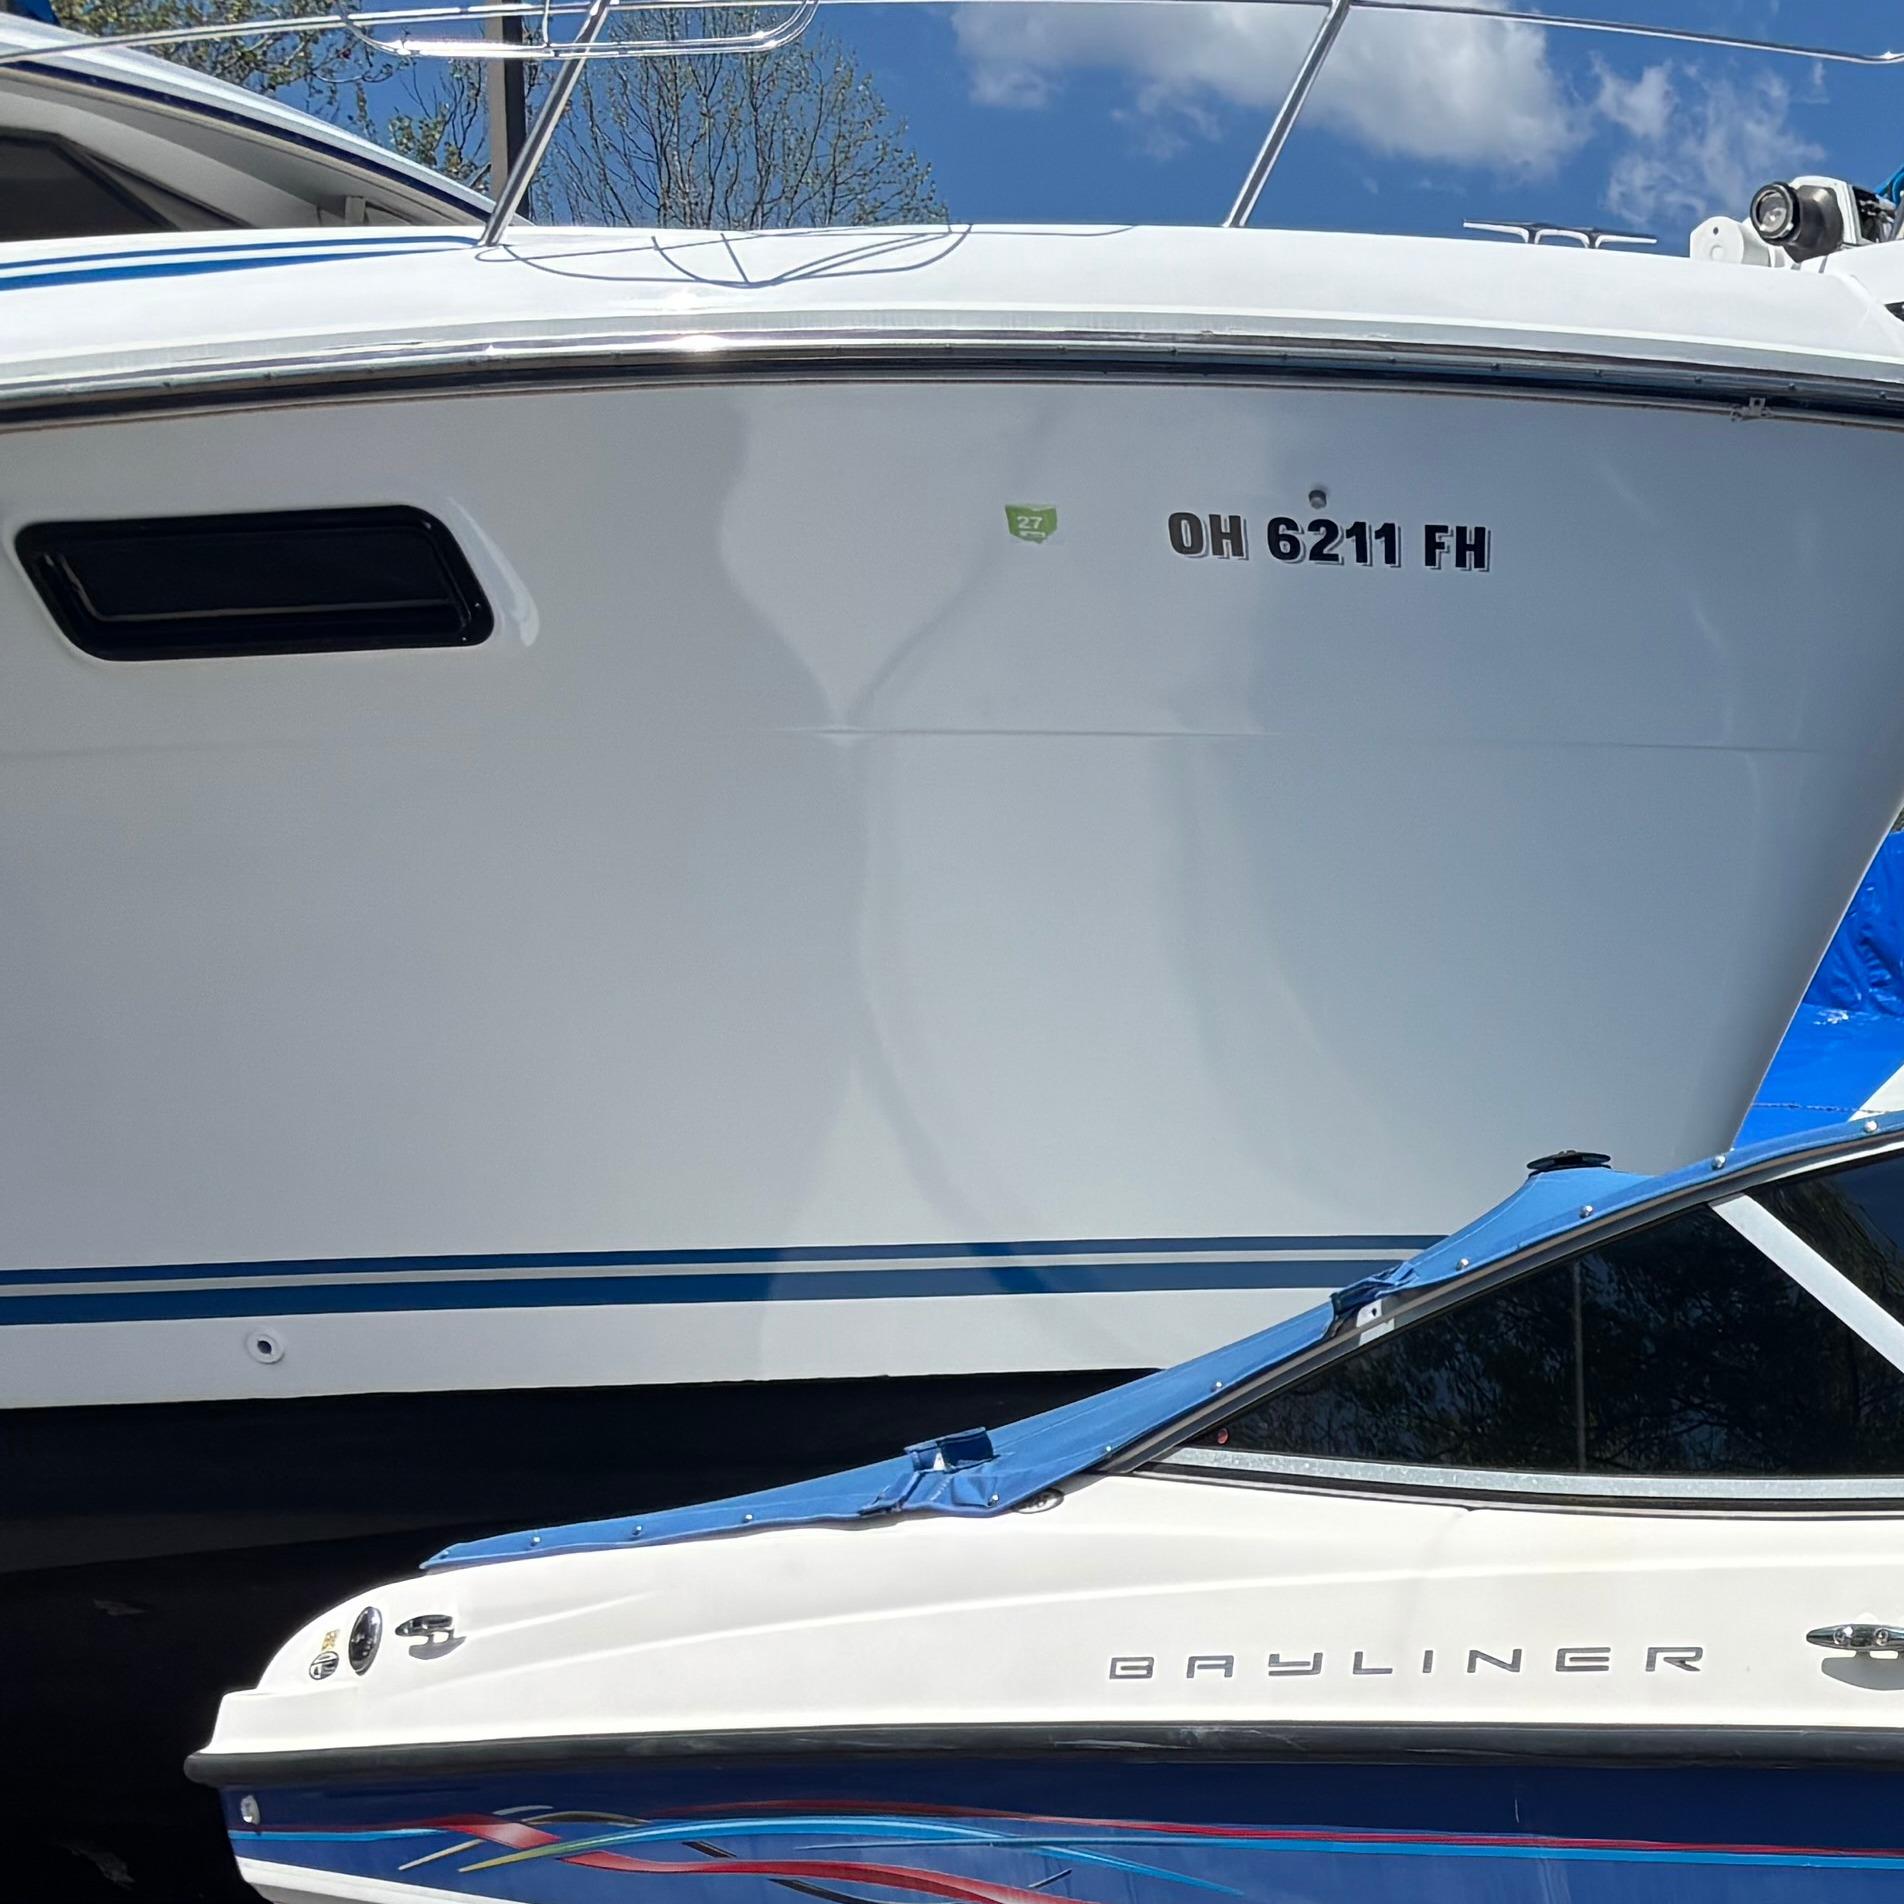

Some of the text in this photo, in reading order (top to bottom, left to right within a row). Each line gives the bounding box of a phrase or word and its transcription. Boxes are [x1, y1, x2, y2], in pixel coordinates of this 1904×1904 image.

[1016, 515, 1043, 529] 27
[1167, 511, 1490, 571] OH 6211 FH
[1107, 1645, 1705, 1681] BAYLINER
